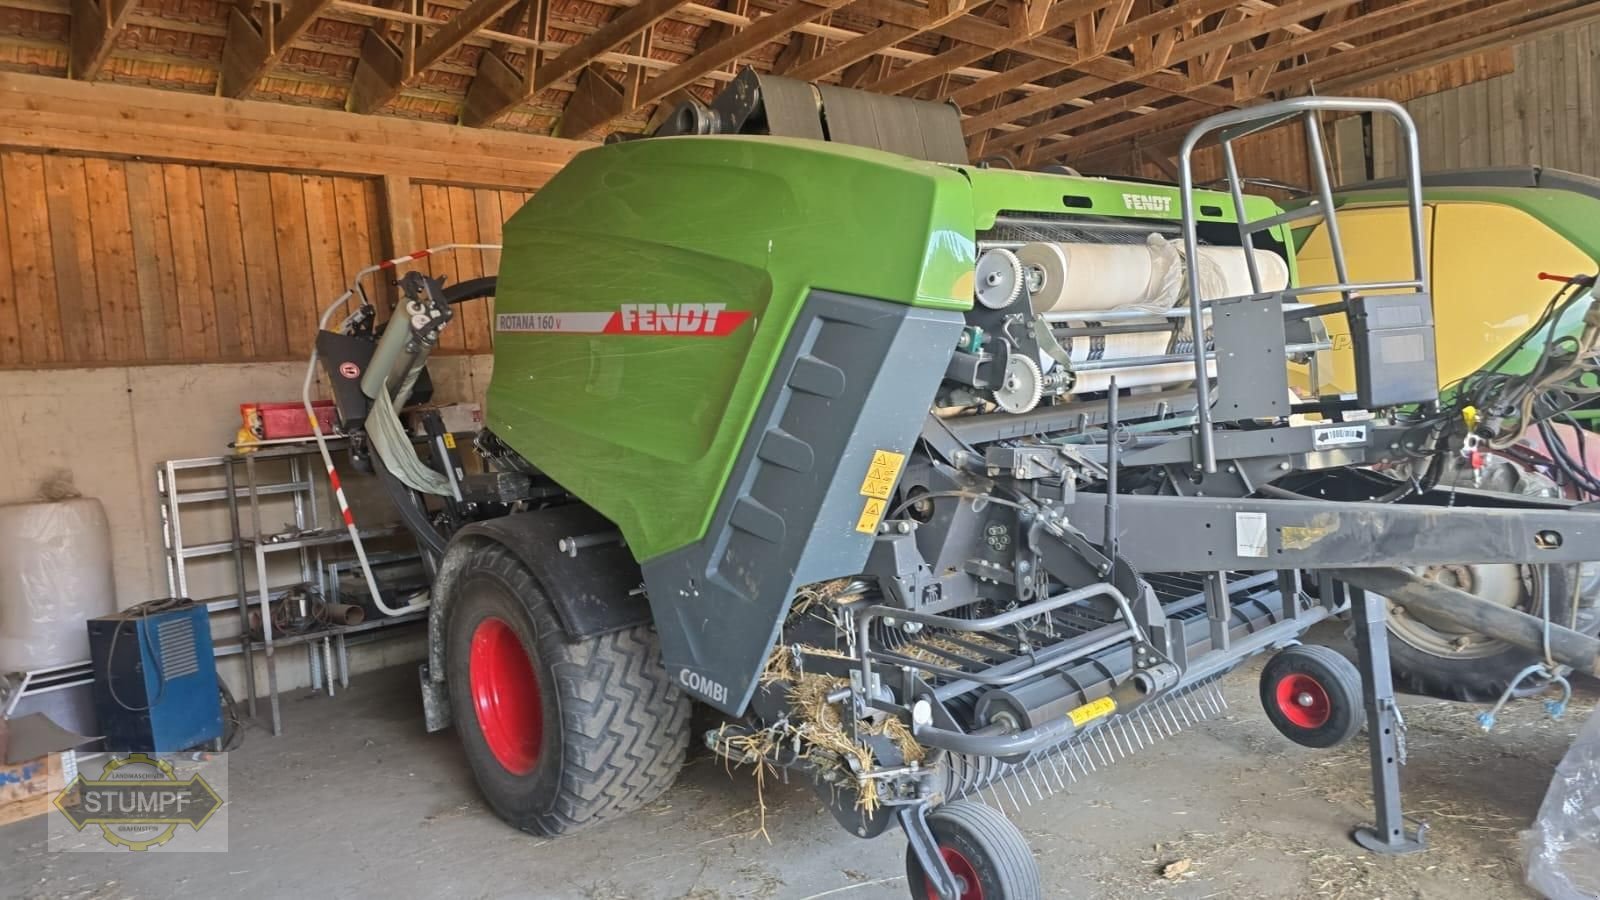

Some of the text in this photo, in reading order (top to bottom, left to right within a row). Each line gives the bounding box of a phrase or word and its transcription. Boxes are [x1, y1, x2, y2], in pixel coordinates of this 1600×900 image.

[1122, 193, 1172, 212] FENDT
[500, 315, 535, 330] ROTANA
[537, 315, 555, 330] 160
[620, 302, 727, 332] FENDT
[680, 668, 728, 705] COMBI
